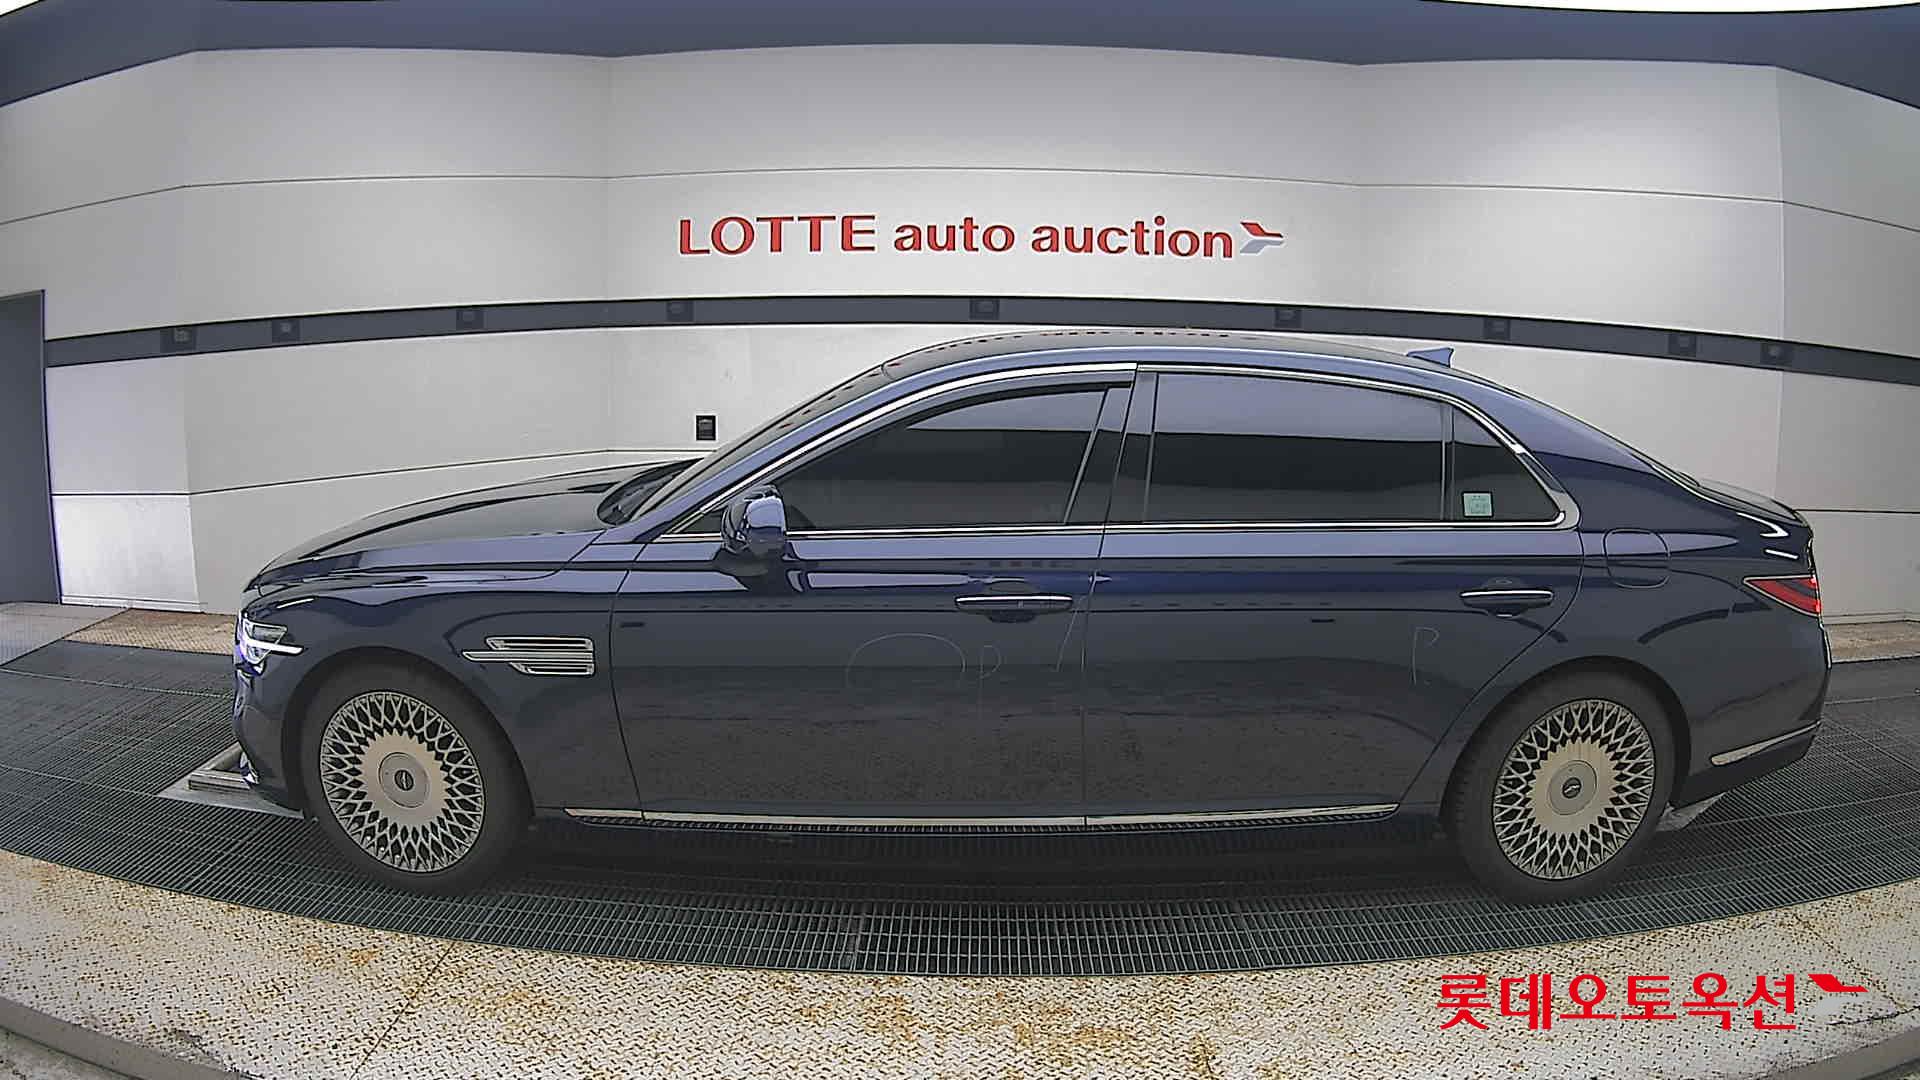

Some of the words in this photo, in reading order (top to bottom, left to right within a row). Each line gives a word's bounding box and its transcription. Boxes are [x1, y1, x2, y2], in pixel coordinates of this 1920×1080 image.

[680, 215, 877, 255] LOTTE
[894, 217, 1015, 252] auto
[1032, 216, 1234, 259] auction
